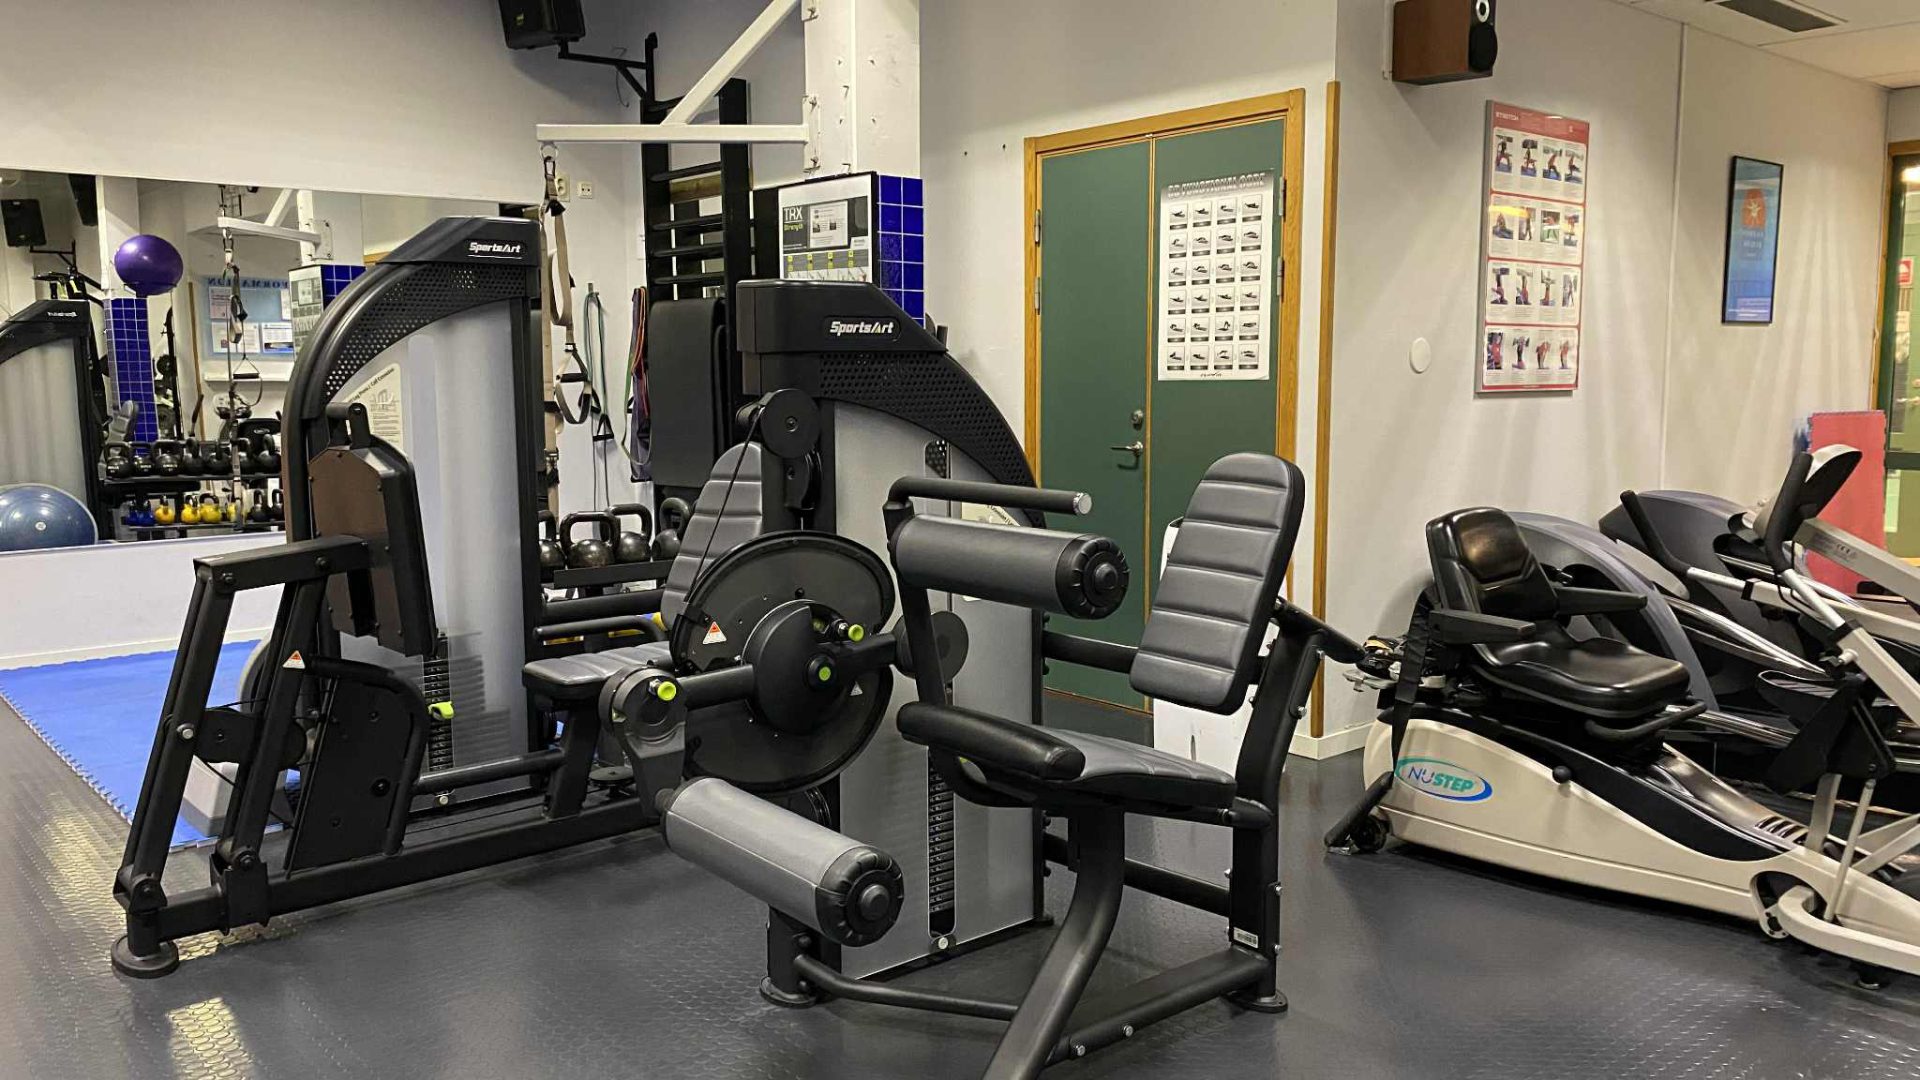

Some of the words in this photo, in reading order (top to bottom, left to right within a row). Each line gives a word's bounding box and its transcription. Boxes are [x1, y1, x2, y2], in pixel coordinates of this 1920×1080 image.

[784, 207, 803, 220] TRX
[469, 242, 521, 254] SportsArt
[829, 321, 894, 337] SportsArt
